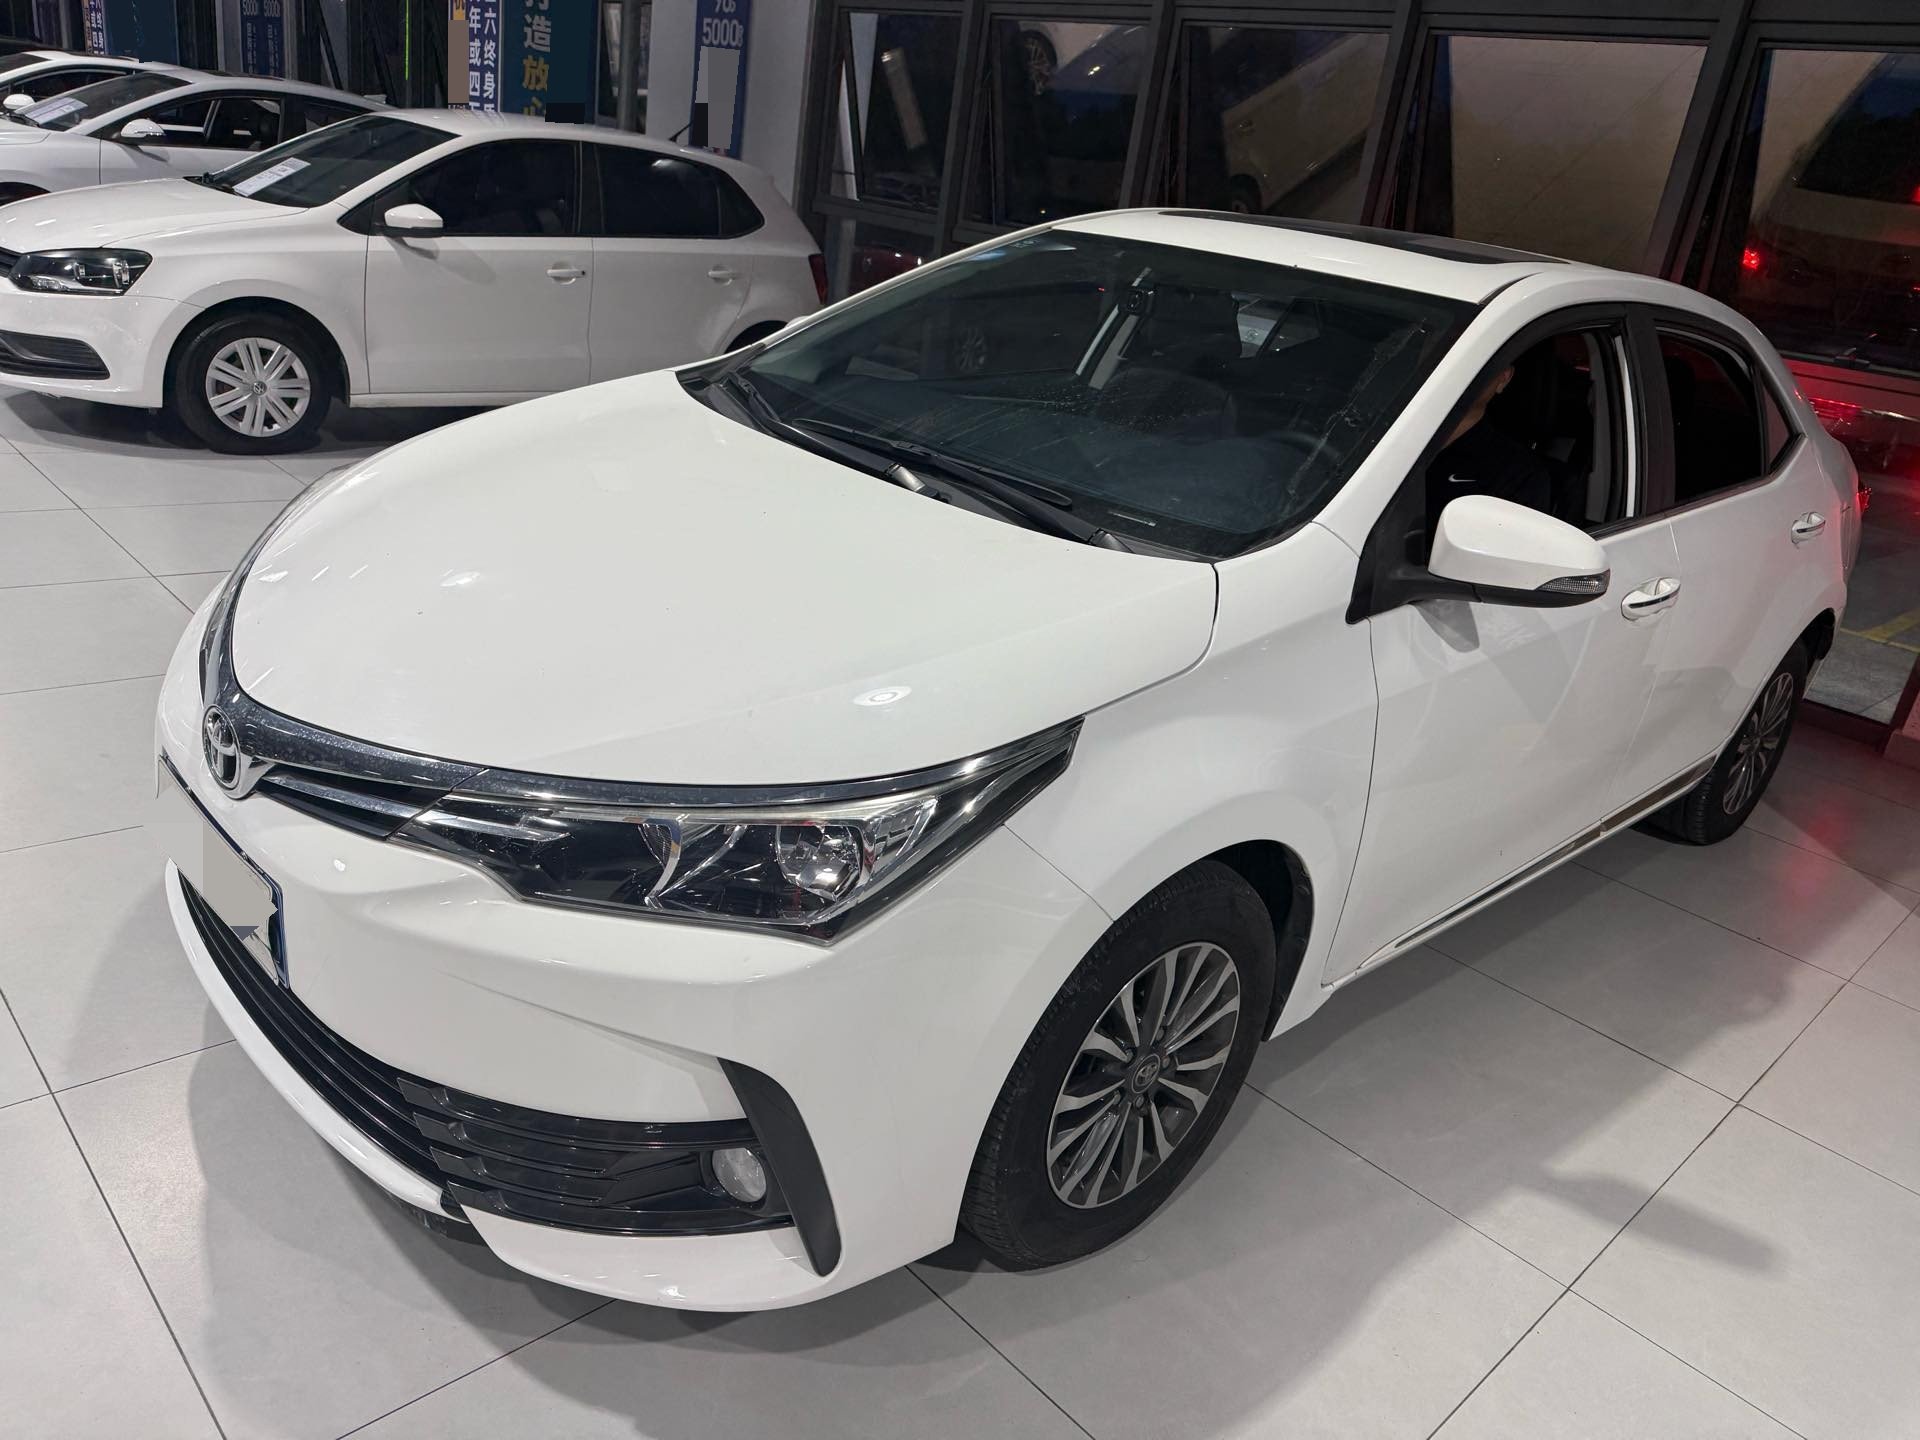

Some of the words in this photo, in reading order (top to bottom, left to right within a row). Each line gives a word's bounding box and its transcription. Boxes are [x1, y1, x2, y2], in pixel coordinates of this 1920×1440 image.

[469, 0, 481, 111] 年或四
[483, 0, 497, 112] 六终身
